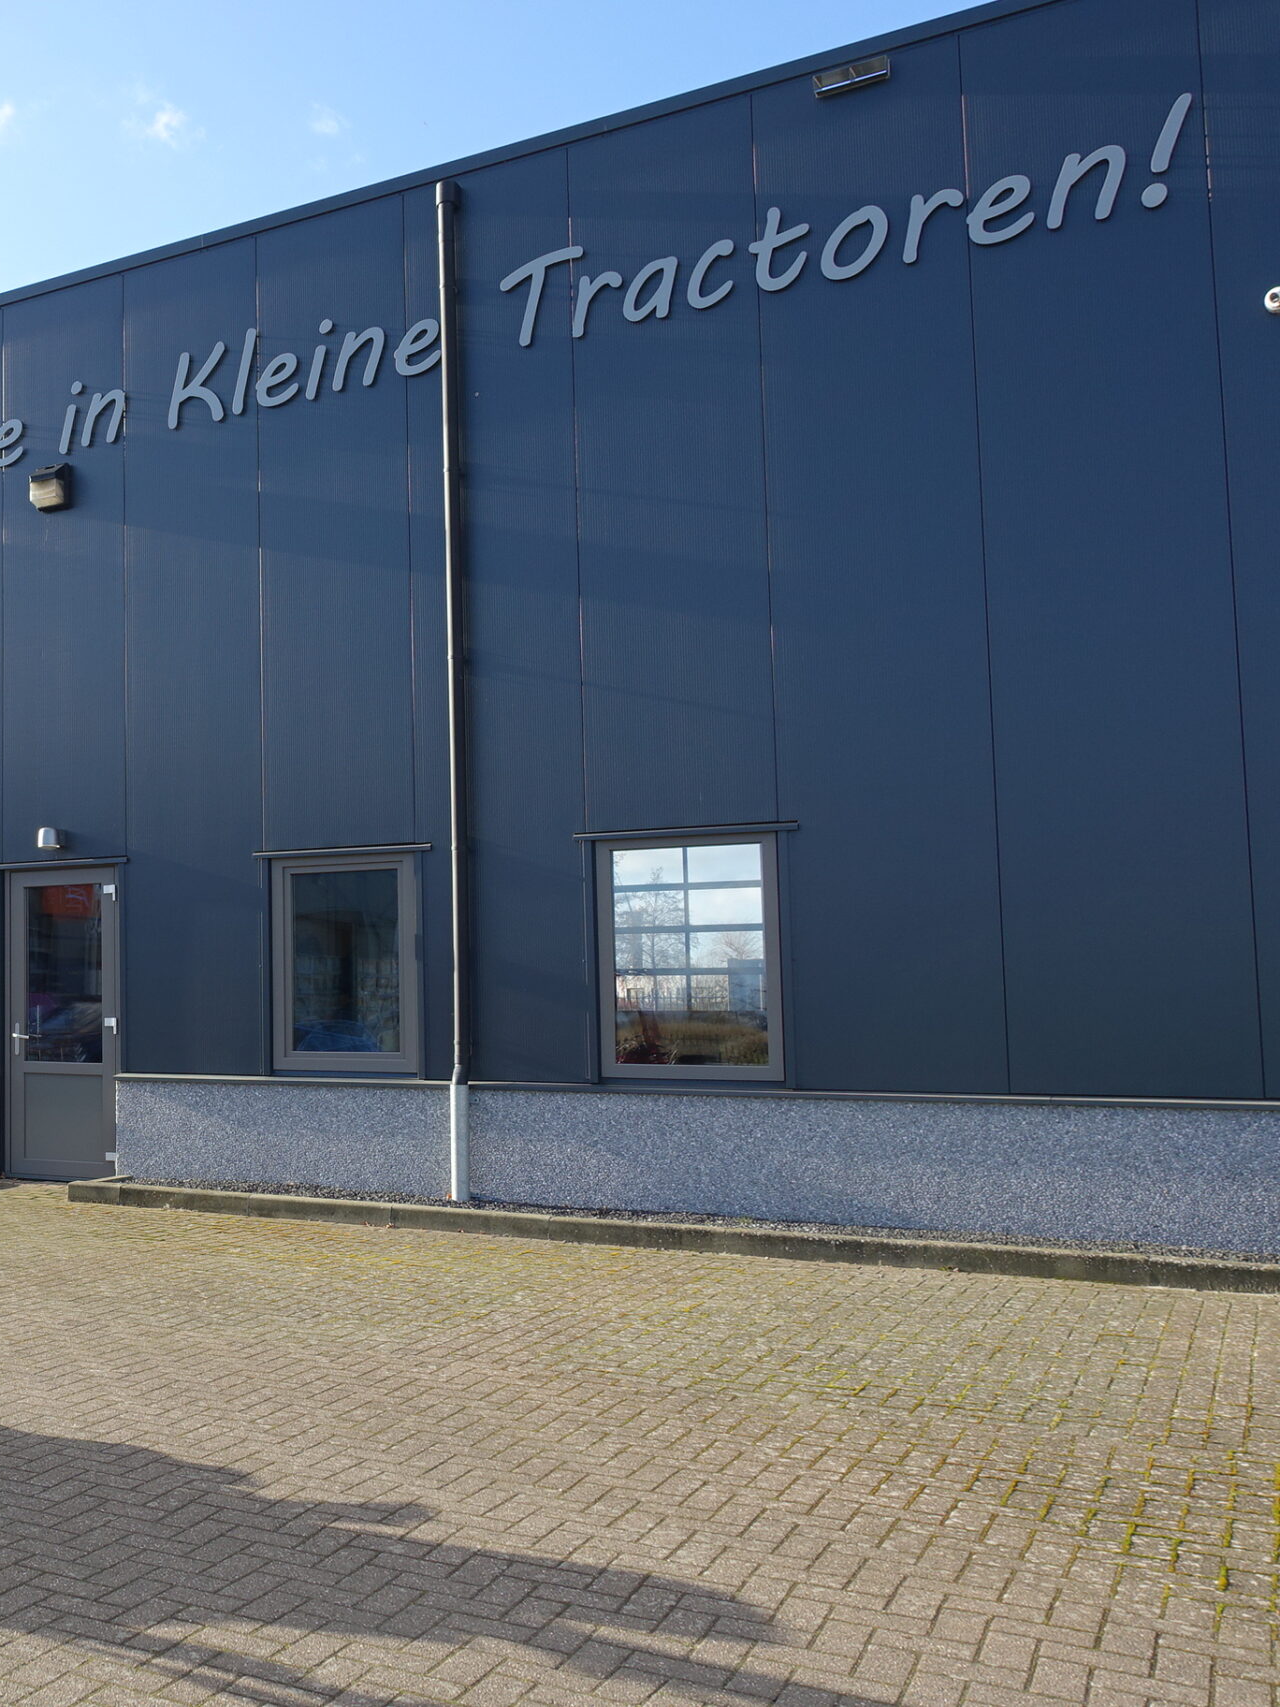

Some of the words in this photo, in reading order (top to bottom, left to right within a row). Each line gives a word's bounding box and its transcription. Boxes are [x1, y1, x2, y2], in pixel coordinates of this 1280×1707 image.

[58, 380, 127, 455] in
[167, 318, 442, 430] Kleine
[499, 92, 1192, 347] Tractoren!
